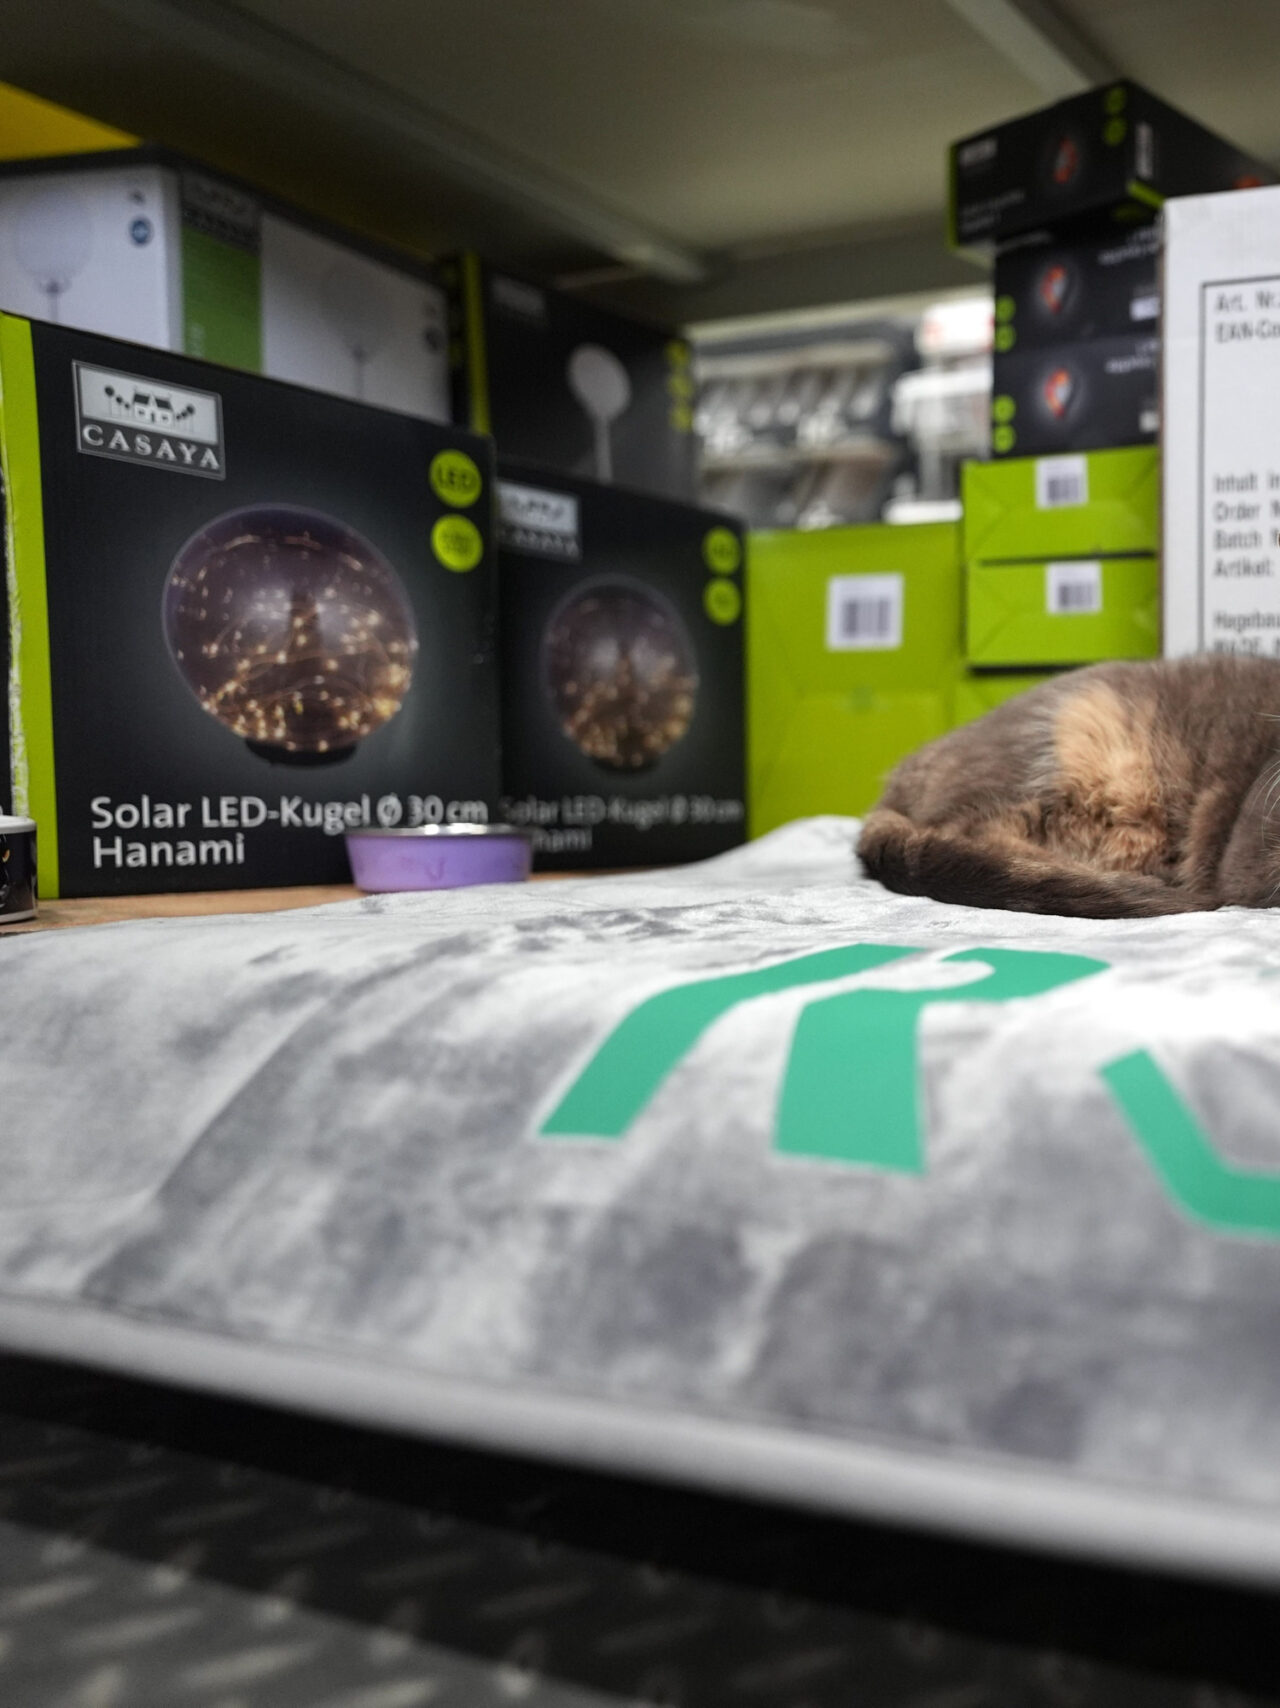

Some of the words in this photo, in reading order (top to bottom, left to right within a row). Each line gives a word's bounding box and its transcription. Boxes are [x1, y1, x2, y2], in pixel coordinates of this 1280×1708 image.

[82, 424, 220, 470] CASAYA
[437, 464, 475, 491] LED
[1214, 472, 1258, 495] Inhalt
[1214, 500, 1261, 522] Order
[1214, 529, 1262, 550] Batch
[91, 794, 192, 829] Solar
[201, 793, 370, 836] LED-Kugel
[408, 794, 444, 827] 30
[445, 799, 489, 824] cm
[93, 832, 245, 869] Hanami
